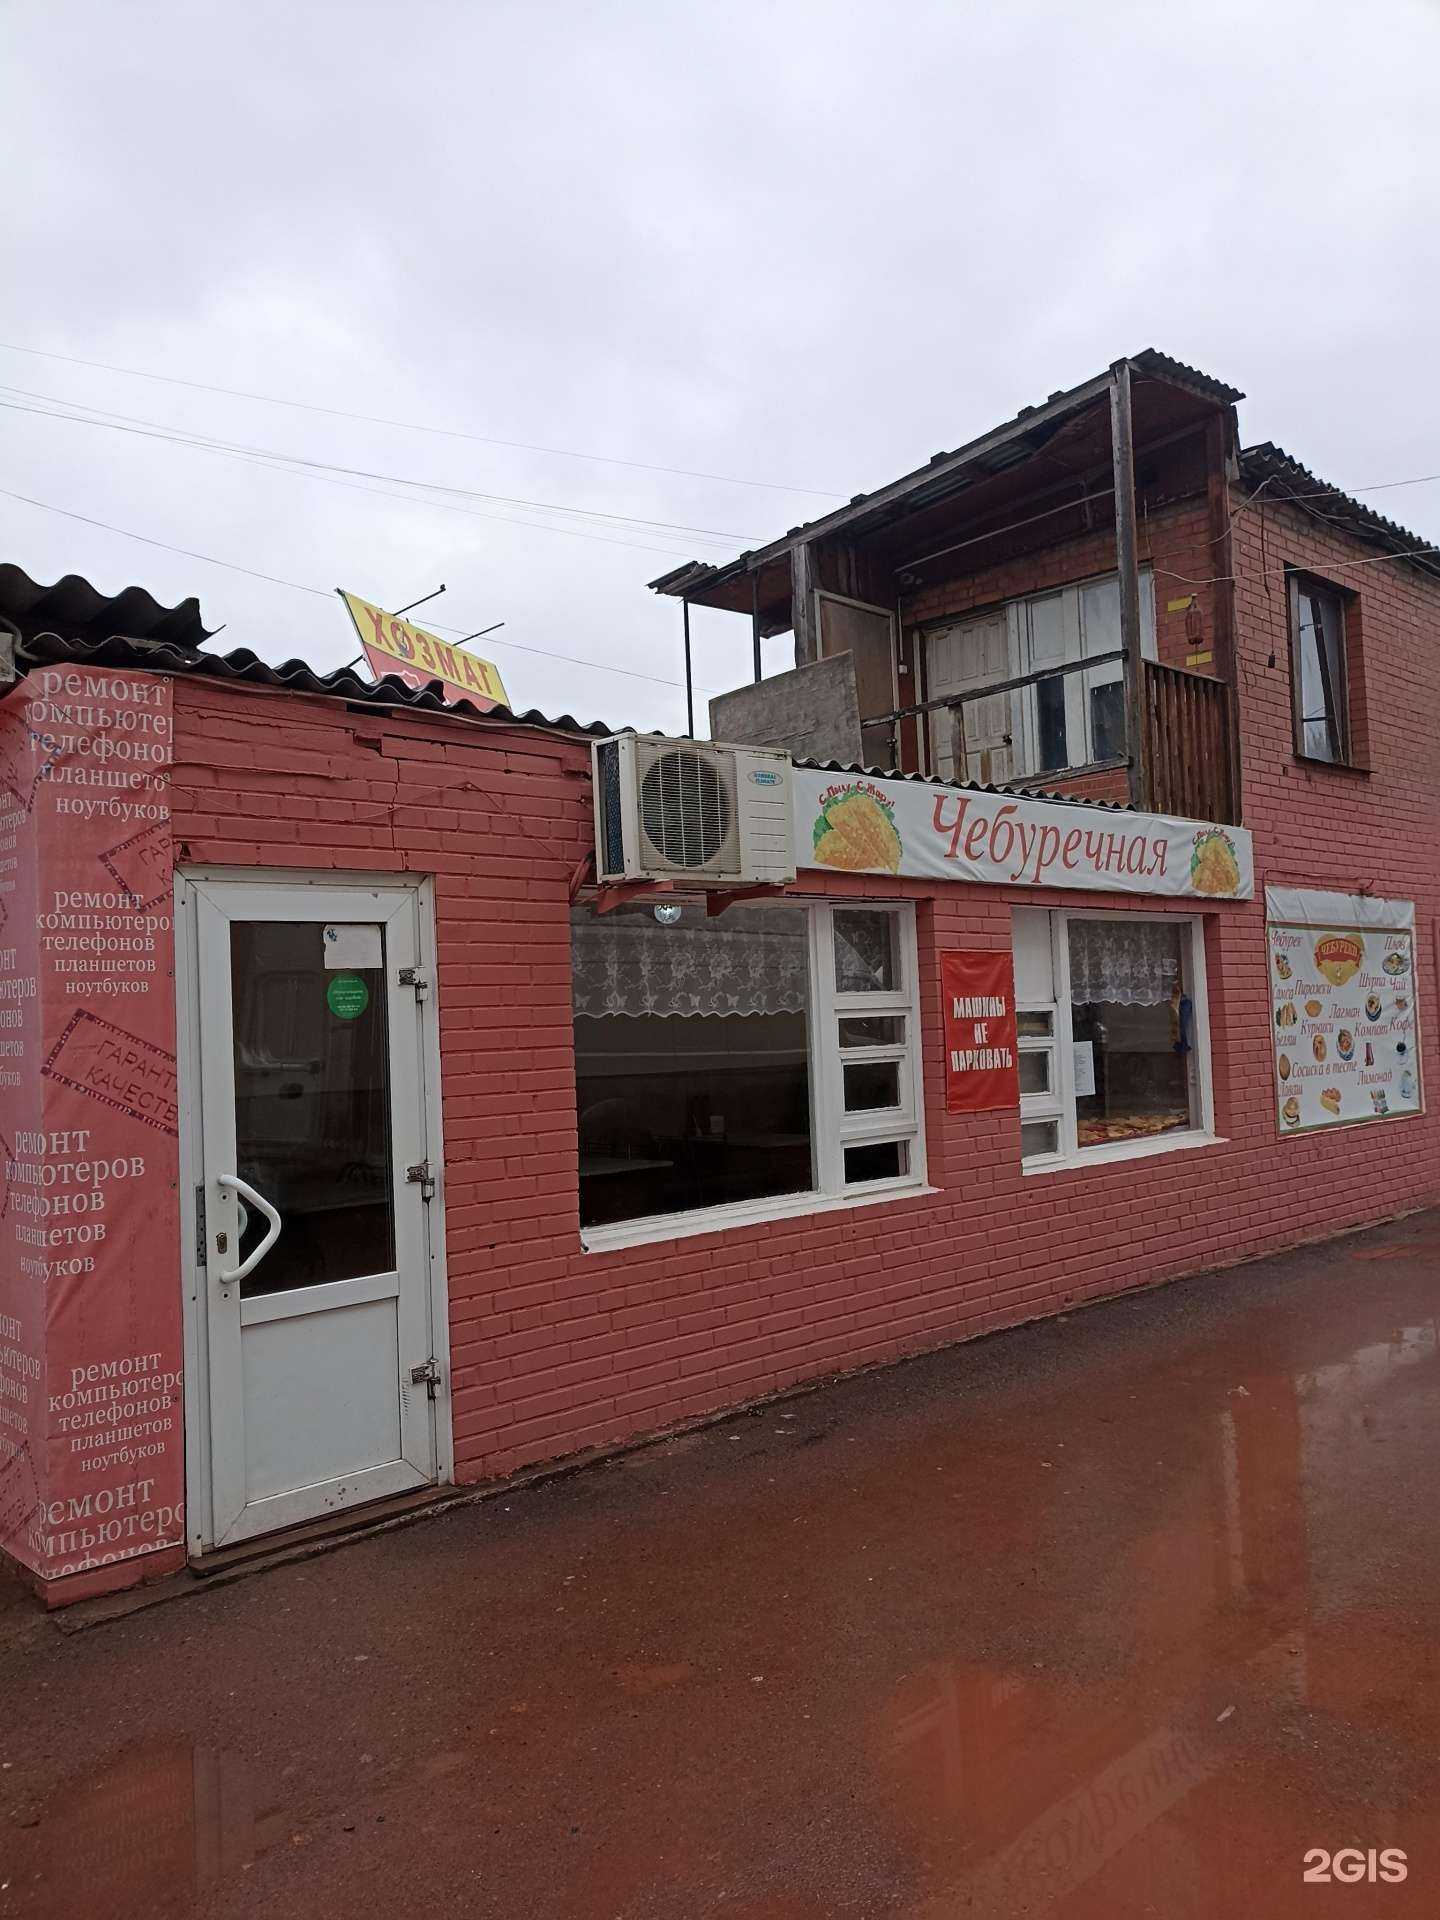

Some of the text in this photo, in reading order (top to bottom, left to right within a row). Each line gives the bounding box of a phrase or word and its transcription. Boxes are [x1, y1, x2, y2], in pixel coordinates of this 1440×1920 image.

[41, 671, 167, 706] ремонт
[55, 796, 170, 822] ноутбуков
[932, 794, 1168, 884] Чебуречная
[54, 890, 144, 914] ремонт
[36, 911, 174, 936] компьютеро
[43, 931, 156, 956] телефонов
[54, 958, 157, 973] планшетов
[66, 978, 150, 999] ноутбуков
[953, 996, 1006, 1019] МАШИНЫ
[974, 1022, 988, 1044] НЕ
[97, 1040, 177, 1092] ГАРАНТ
[951, 1047, 1013, 1072] ПАРКОВАТЬ
[15, 1130, 91, 1160] ремонт
[5, 1157, 146, 1188] компьютеров
[9, 1189, 105, 1222] телефонов
[15, 1223, 106, 1247] планшетов
[20, 1256, 96, 1283] ноутбуков
[71, 1352, 162, 1391] ремонт
[59, 1395, 172, 1432] телефонов
[71, 1417, 173, 1452] планшетов
[81, 1441, 165, 1472] ноутбуков
[38, 1478, 155, 1532] ремонт
